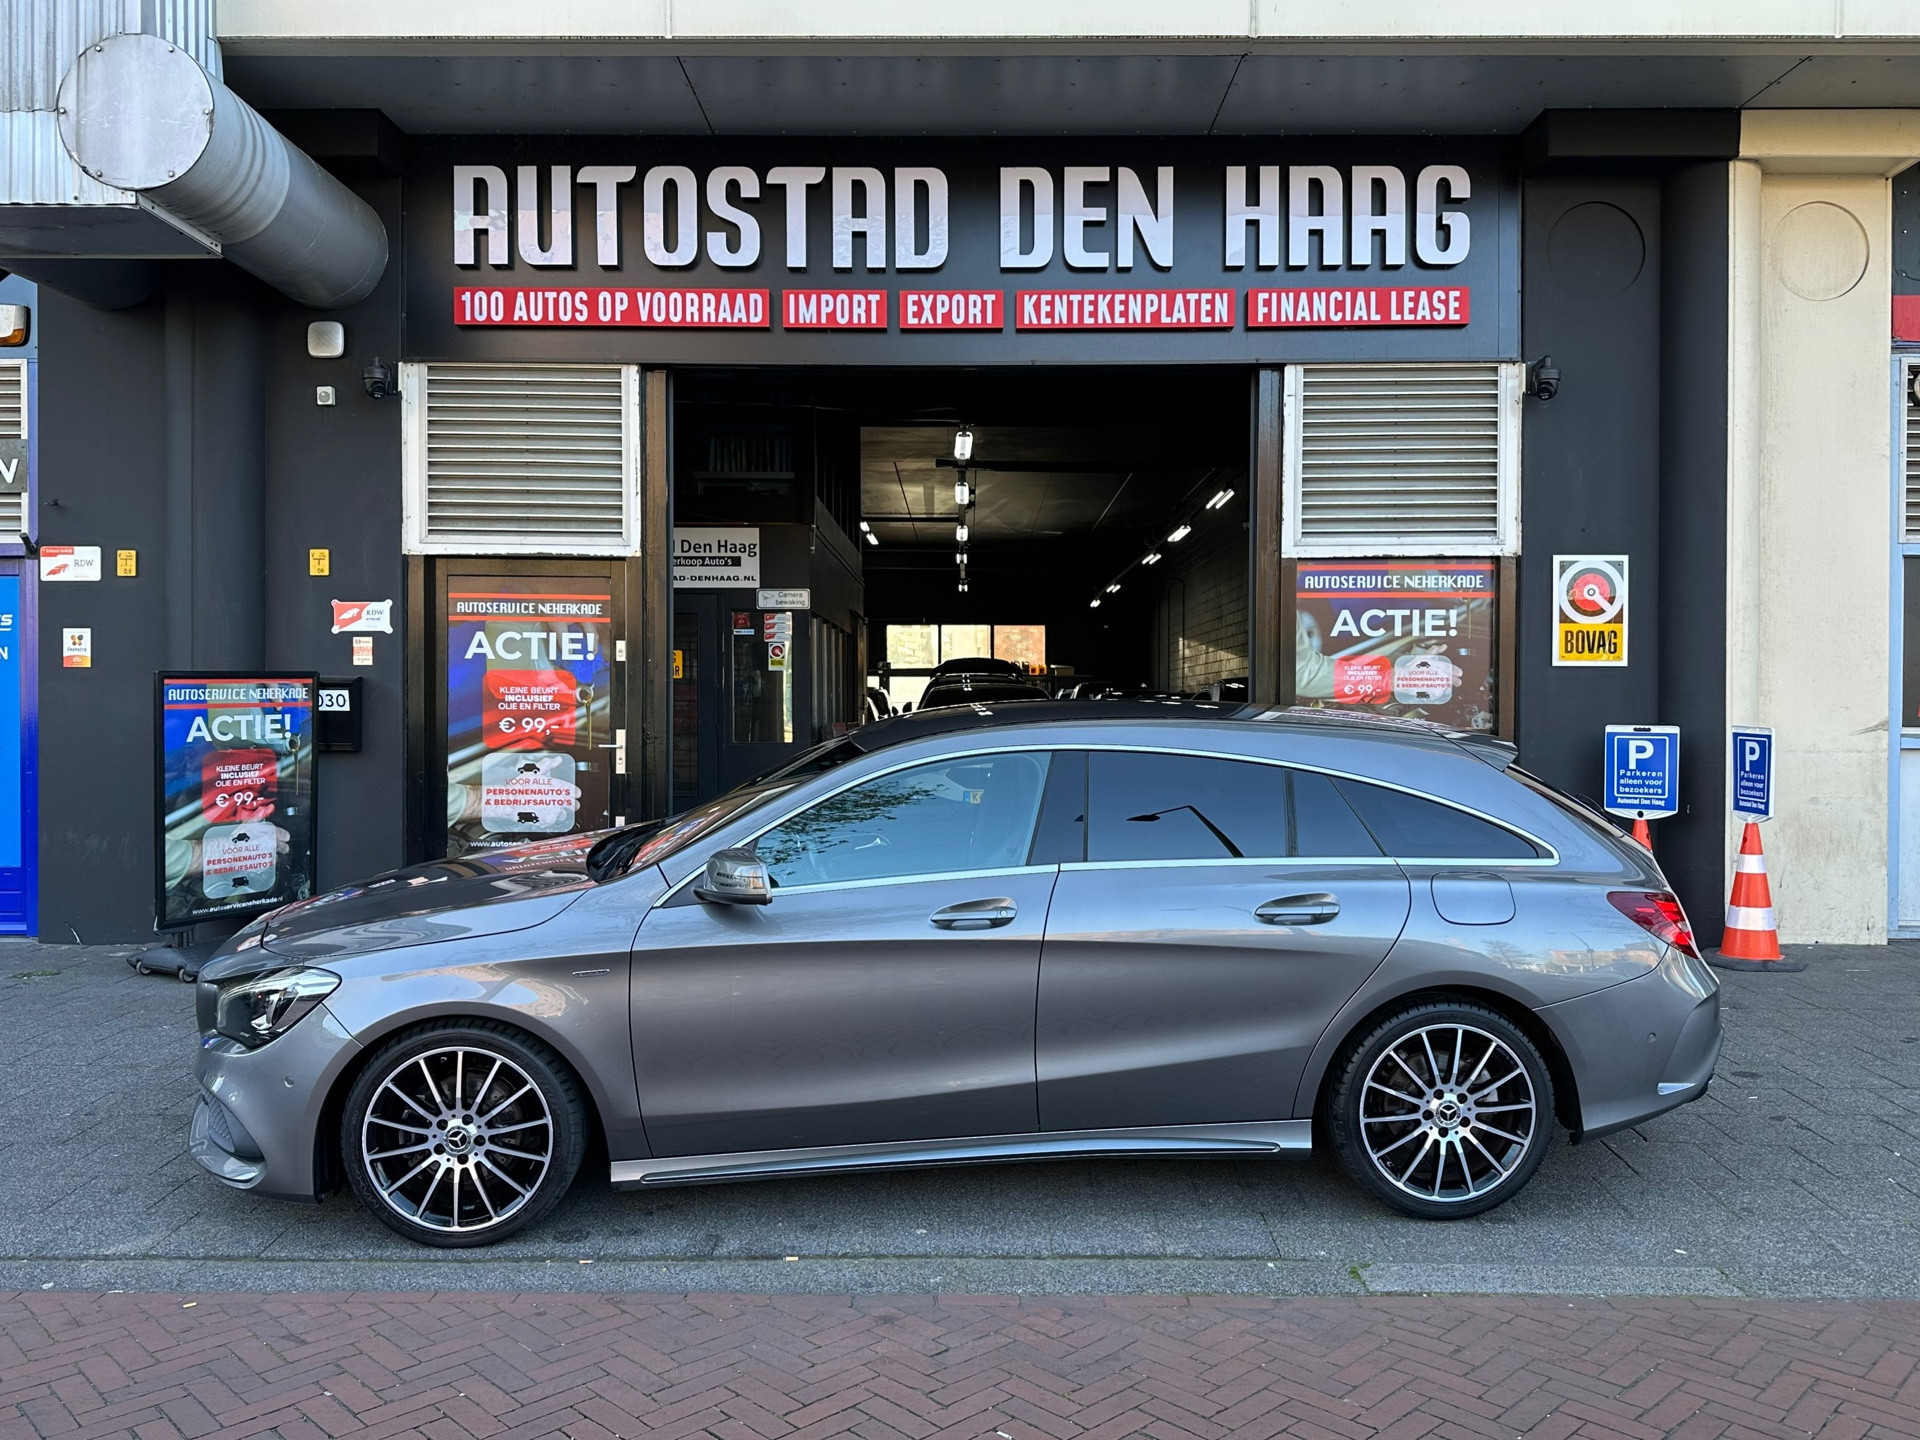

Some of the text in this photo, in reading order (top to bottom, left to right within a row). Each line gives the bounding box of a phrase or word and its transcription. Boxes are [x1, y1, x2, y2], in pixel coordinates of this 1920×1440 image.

[454, 165, 1471, 269] AUTOSTAD DEN HAAG
[461, 290, 764, 324] 100 AUTOS OP VOORRAAD
[789, 293, 880, 325] IMPORT
[907, 293, 996, 325] EXPORT
[1023, 294, 1229, 325] KENTEKENPLATEN
[1257, 290, 1461, 323] FINANCIAL LEASE
[681, 539, 712, 553] Den
[717, 539, 757, 557] Haag
[74, 559, 94, 567] RDW
[704, 557, 732, 566] Auto's
[1304, 574, 1484, 589] AUTOSERVICE NEHERKADE
[456, 601, 602, 615] AUTOSERVICE NEHERKADE
[1329, 609, 1458, 637] ACTIE!
[464, 630, 595, 661] ACTIE!
[1564, 630, 1618, 654] BOVAG
[168, 687, 309, 700] AUTOSERVICE NEHERKADE
[499, 686, 559, 694] KLEINE BEURT
[1344, 684, 1381, 696] € 99,-
[505, 694, 554, 702] INCLUSIEF
[533, 703, 561, 711] FILTER
[186, 713, 292, 743] ACTIE!
[499, 717, 560, 736] € 99,-
[1628, 739, 1655, 769] P
[1745, 740, 1760, 771] P
[216, 763, 264, 772] KLEINE BEURT
[1619, 769, 1663, 777] Parkeren
[215, 779, 232, 787] OLIE
[243, 777, 266, 785] FILTER
[221, 771, 260, 780] INCLUSIEF
[1740, 770, 1765, 780] Parkeren
[486, 788, 571, 796] PERSONENAUTO'S
[1619, 785, 1663, 794] bezoekers
[215, 792, 264, 808] € 99,-
[485, 798, 572, 806] & BEDRIJFSAUTO'S
[1651, 799, 1665, 807] Haag
[222, 844, 260, 854] VOOR ALLE
[206, 852, 273, 866] PERSONENAUTO'S
[213, 860, 274, 875] BEDRIJFSAUTO'S
